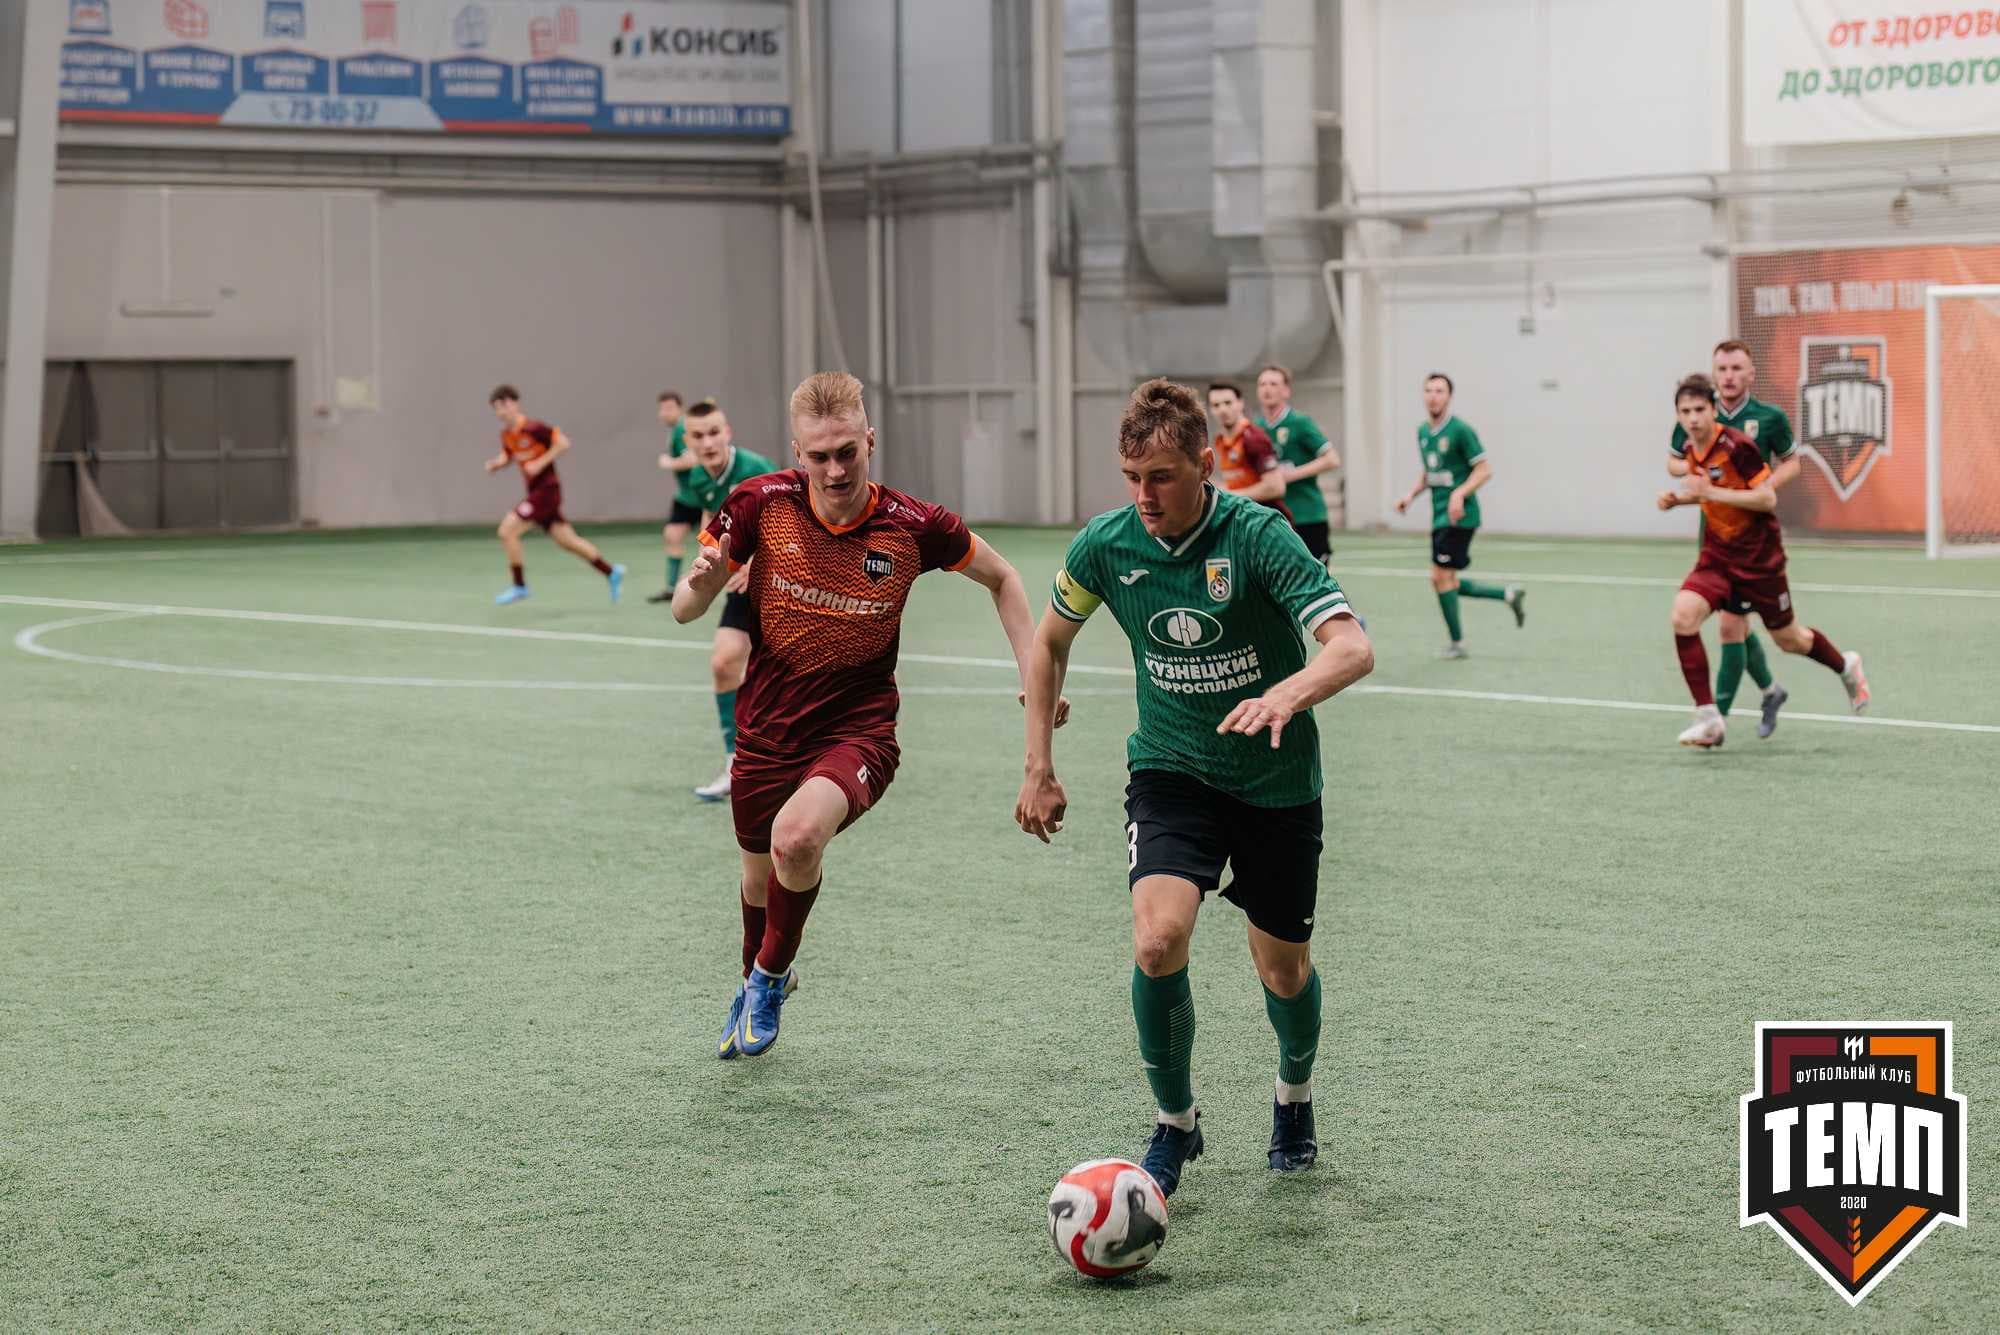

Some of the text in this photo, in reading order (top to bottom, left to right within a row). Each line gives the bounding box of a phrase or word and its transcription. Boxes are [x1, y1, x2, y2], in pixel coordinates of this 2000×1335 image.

[651, 28, 779, 56] КОНСИБ
[1828, 21, 1867, 47] ОТ
[1778, 67, 1821, 101] ДО
[1804, 381, 1883, 440] ТЕМП
[866, 559, 891, 575] ТЕМП
